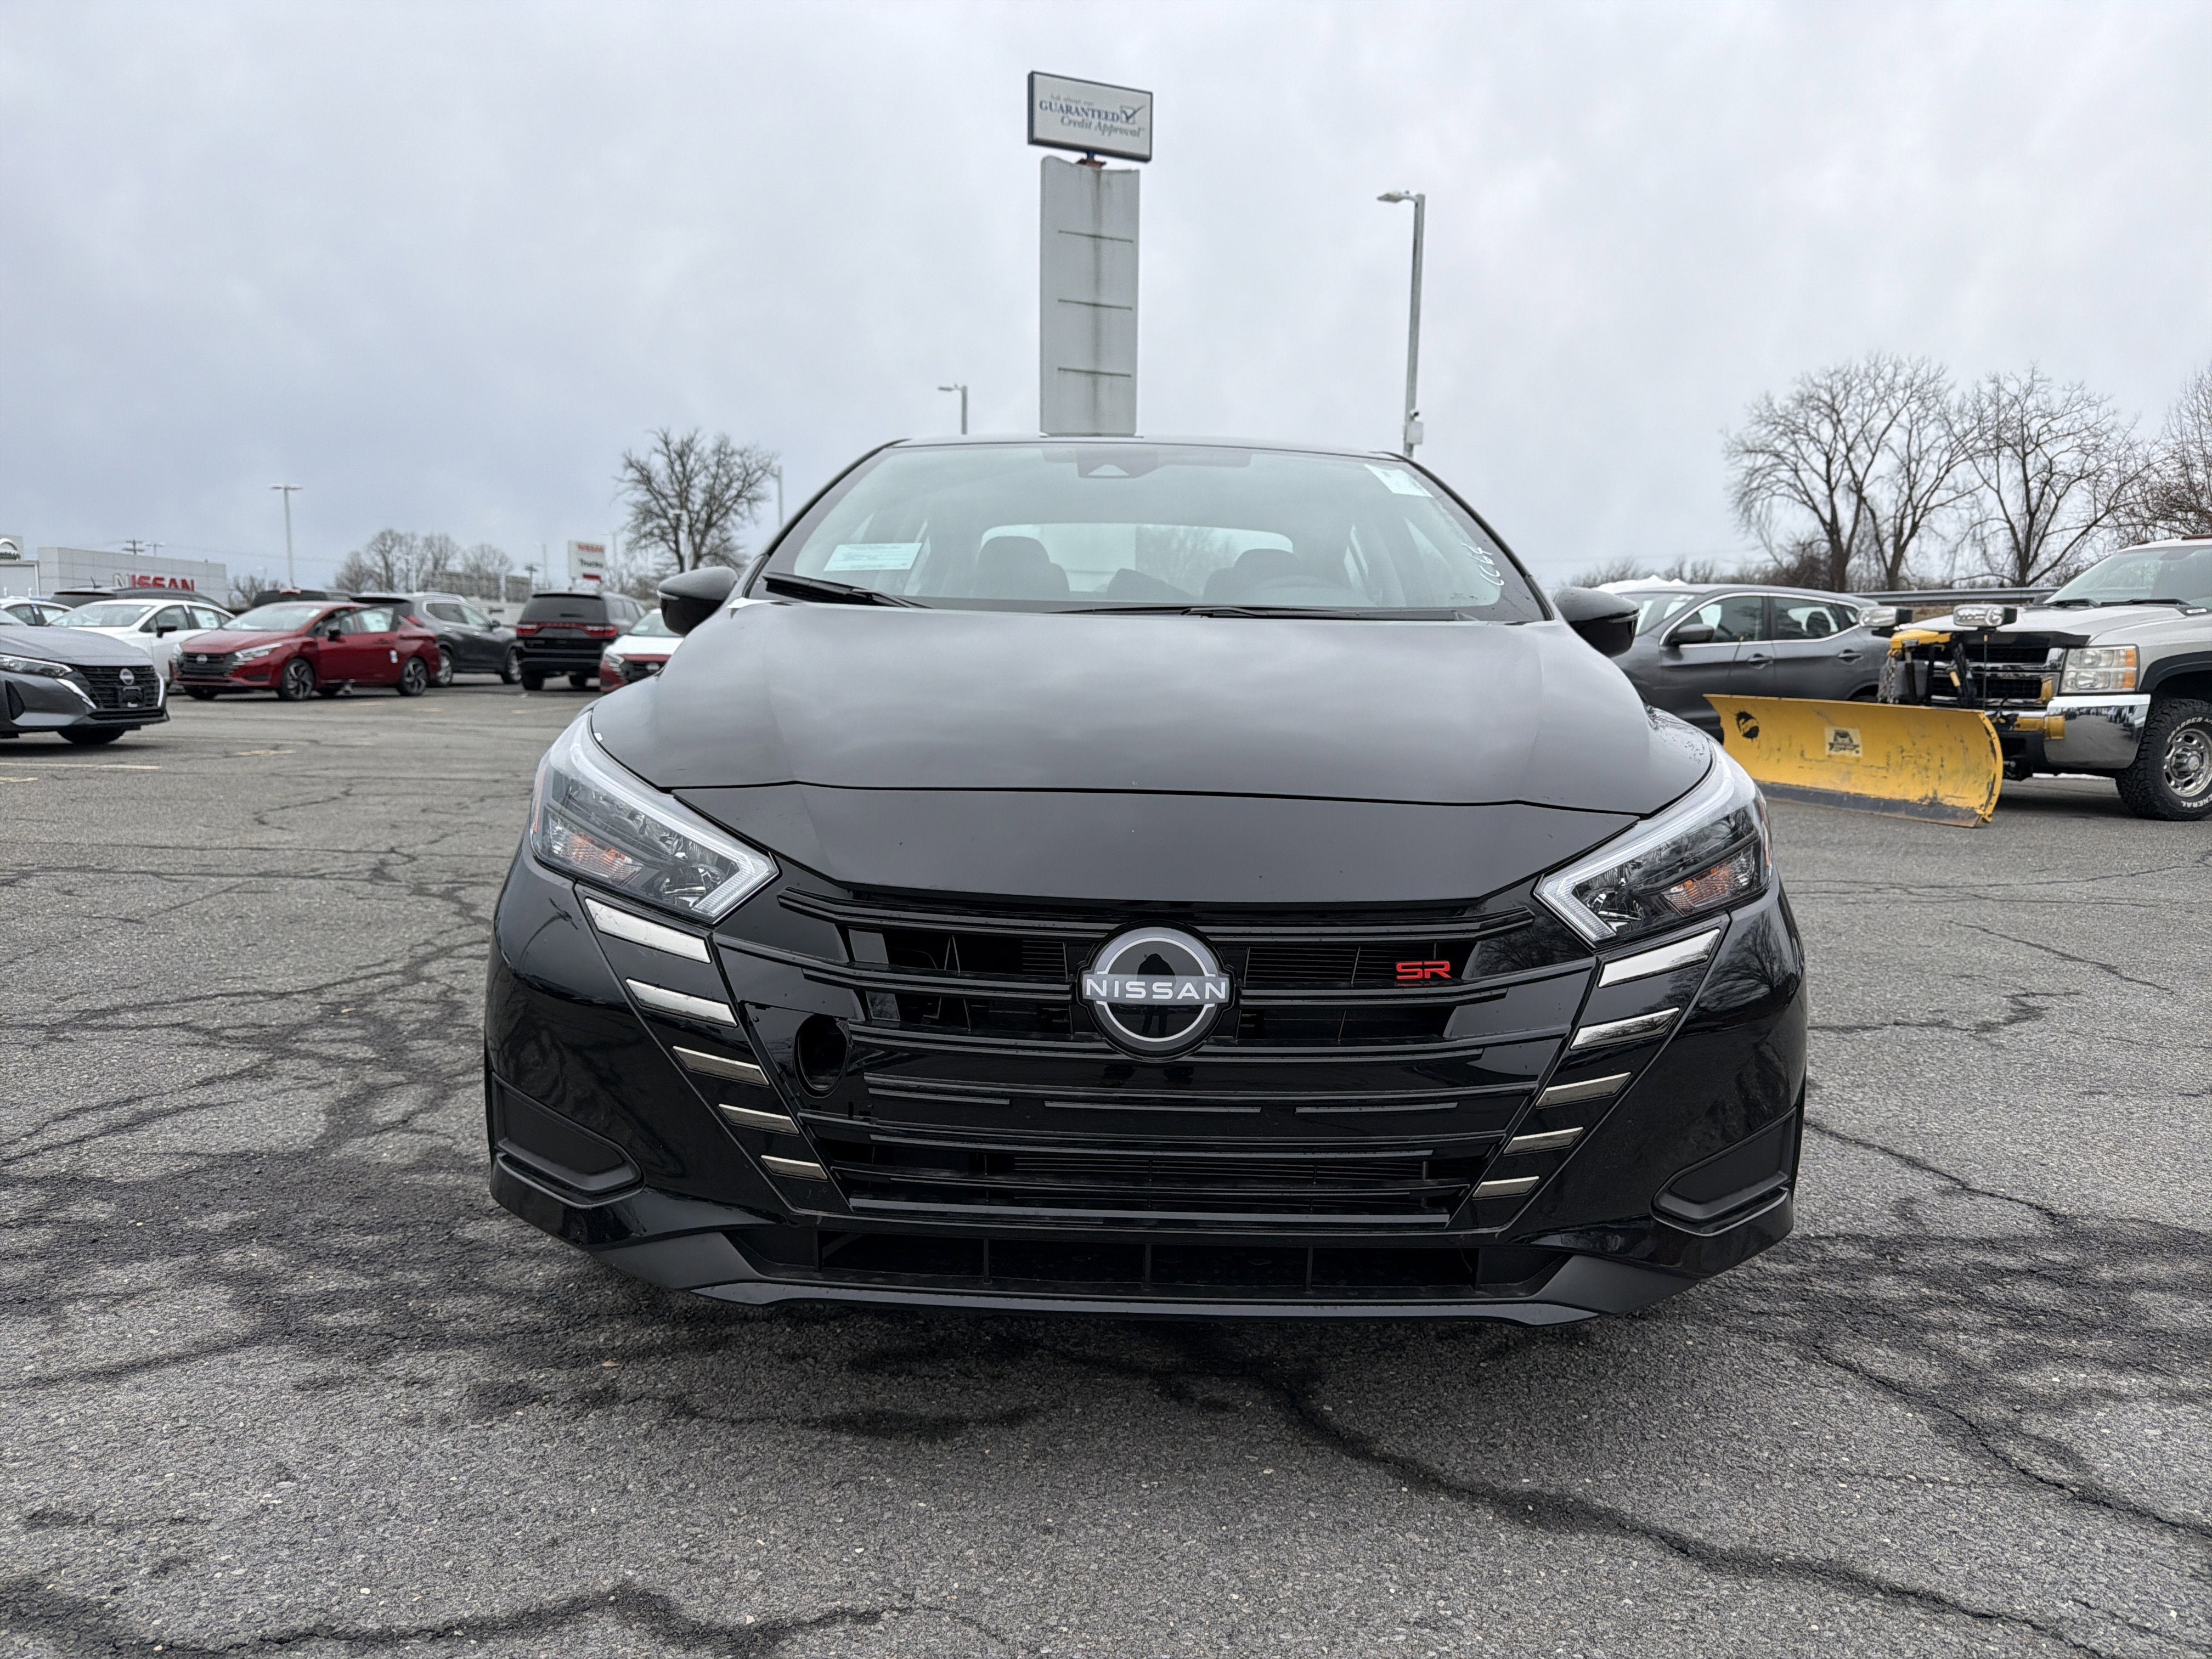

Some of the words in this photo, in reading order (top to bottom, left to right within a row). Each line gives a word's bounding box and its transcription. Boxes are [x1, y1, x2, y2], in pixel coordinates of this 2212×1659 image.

[1039, 99, 1120, 122] GUARANTEED
[1060, 115, 1092, 129] Credit
[1093, 121, 1142, 137] Approved
[113, 572, 195, 592] NISSAN
[2180, 793, 2212, 808] ENERAL
[1396, 961, 1453, 980] SR
[1086, 978, 1226, 1000] NISSAN
